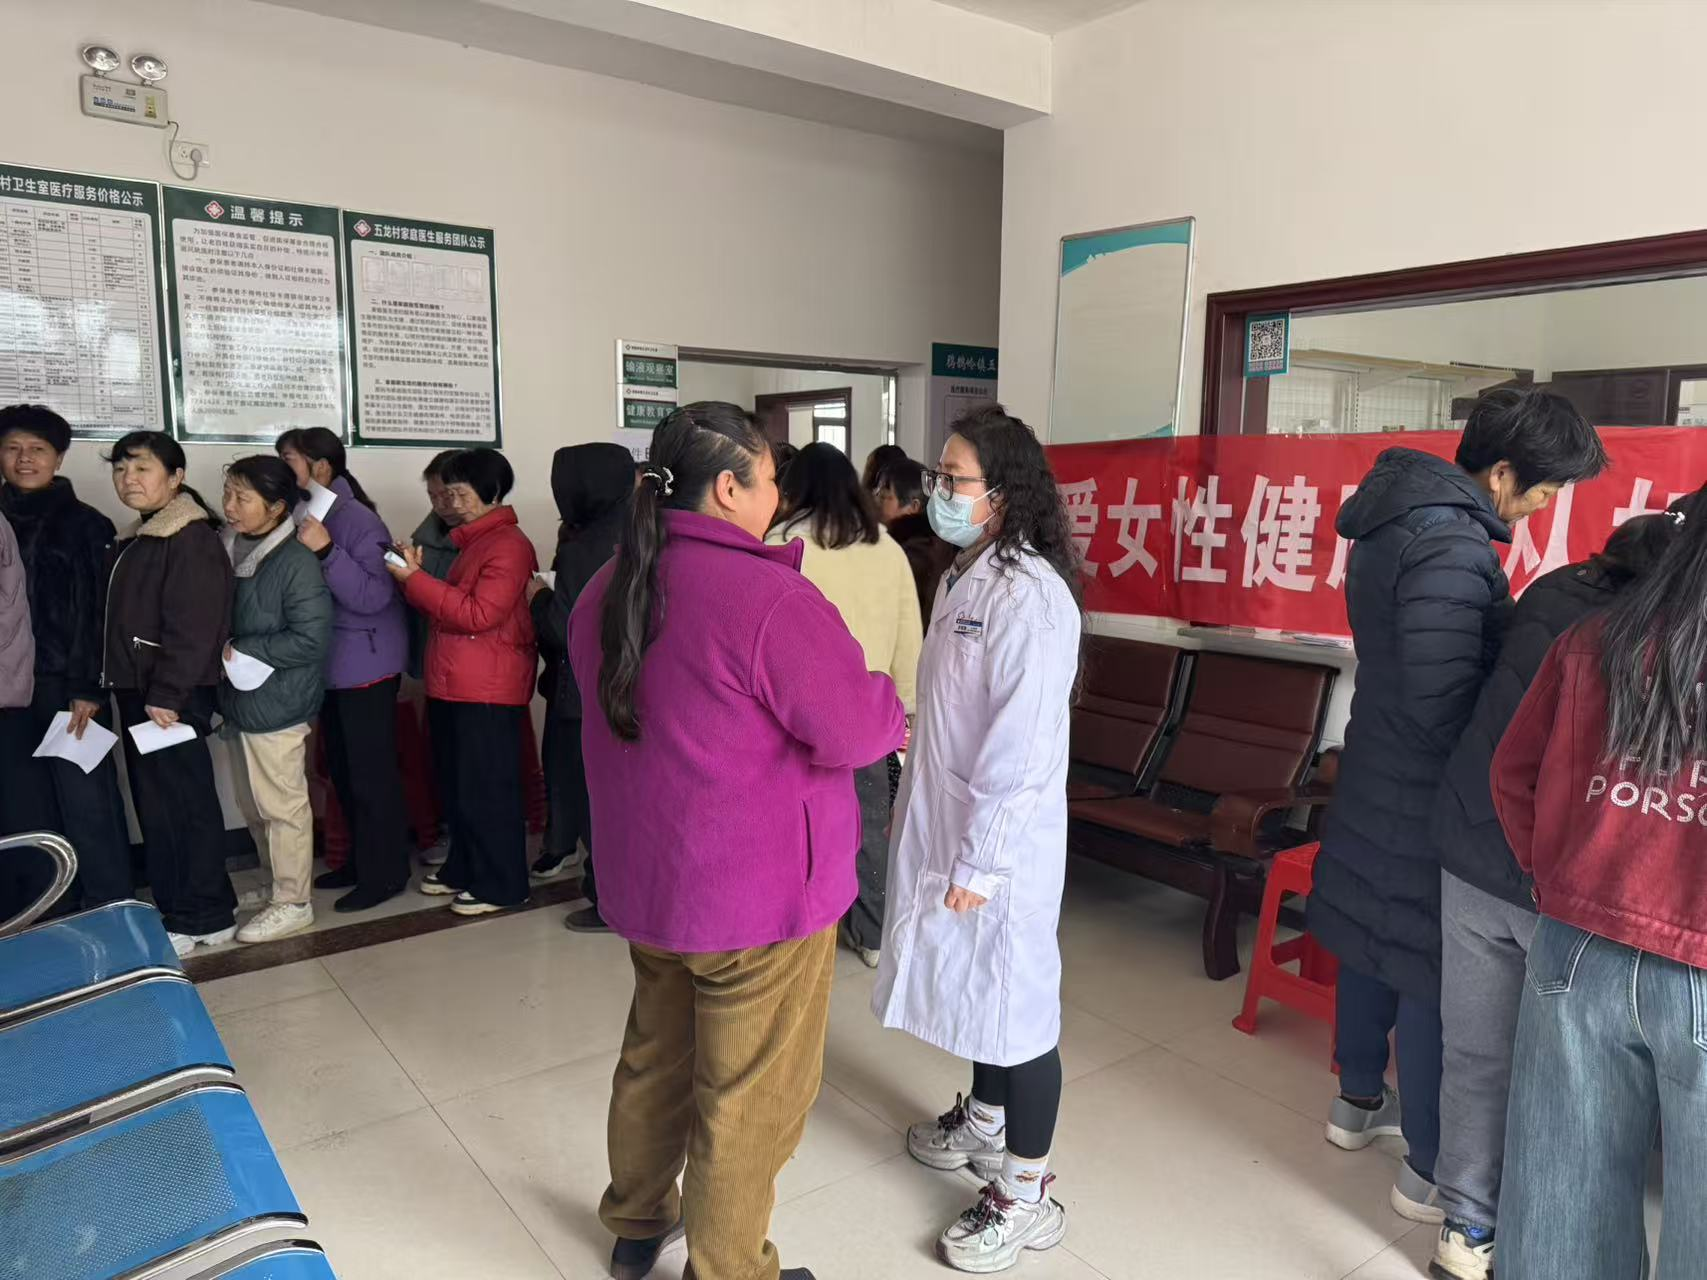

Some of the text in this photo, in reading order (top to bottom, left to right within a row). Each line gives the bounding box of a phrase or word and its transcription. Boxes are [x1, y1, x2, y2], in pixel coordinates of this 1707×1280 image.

[0, 175, 144, 207] 村卫生室医疗服务价格公示
[230, 205, 303, 227] 温馨提示
[374, 223, 486, 249] 五龙村家庭医生服务团队公示
